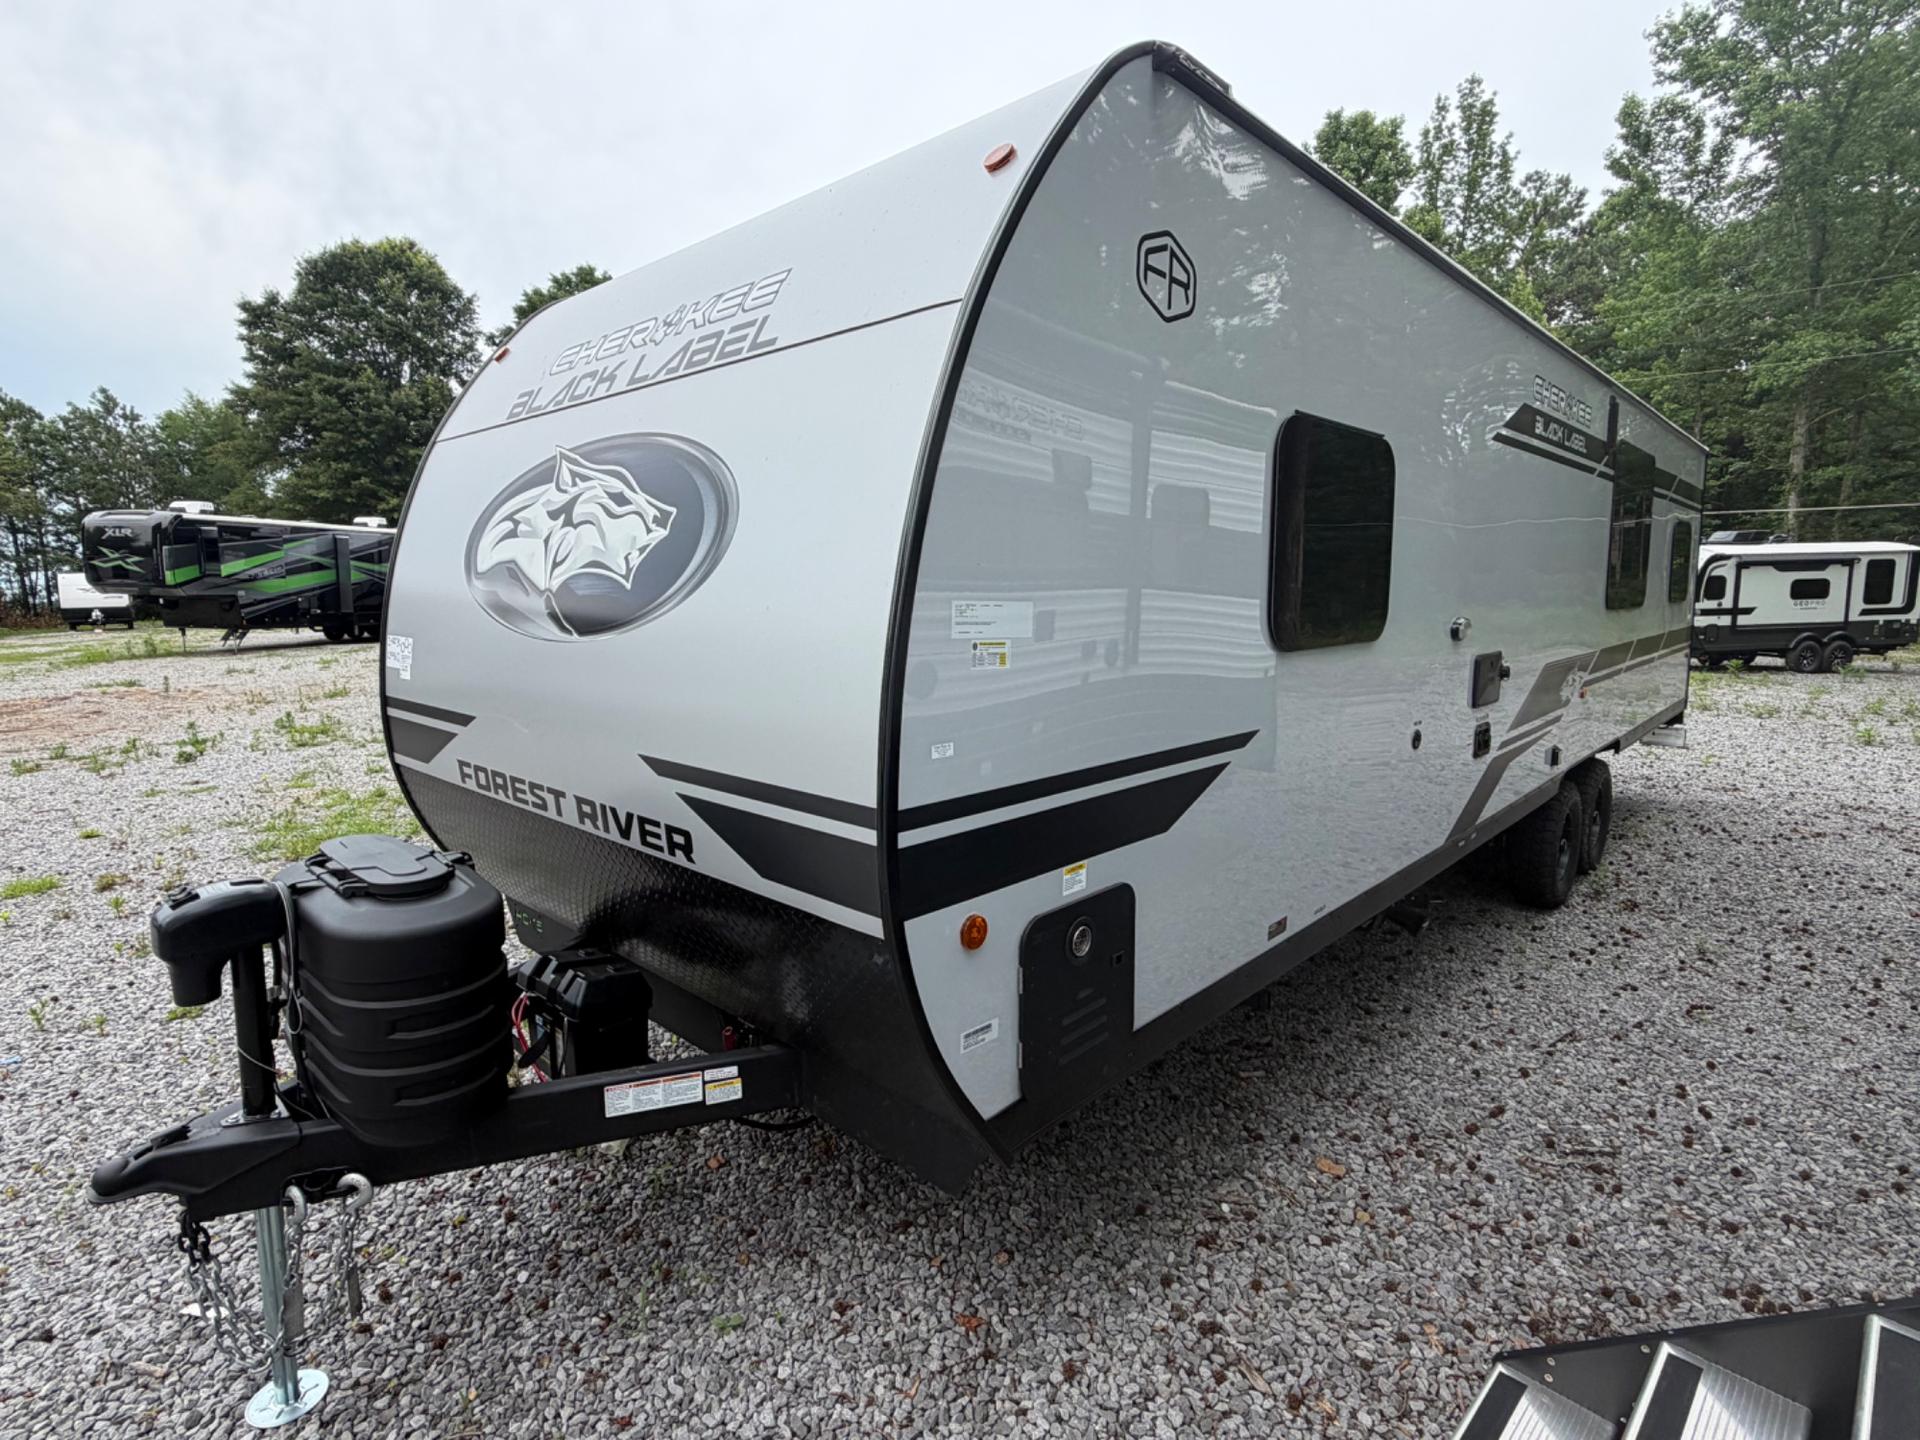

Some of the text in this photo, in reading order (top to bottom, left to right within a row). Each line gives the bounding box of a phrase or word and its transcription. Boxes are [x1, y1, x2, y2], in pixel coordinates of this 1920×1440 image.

[506, 314, 779, 420] BLACK LABEL
[1535, 415, 1588, 453] BLACK LABEL
[101, 527, 133, 540] XLR
[456, 758, 696, 865] FOREST RIVER
